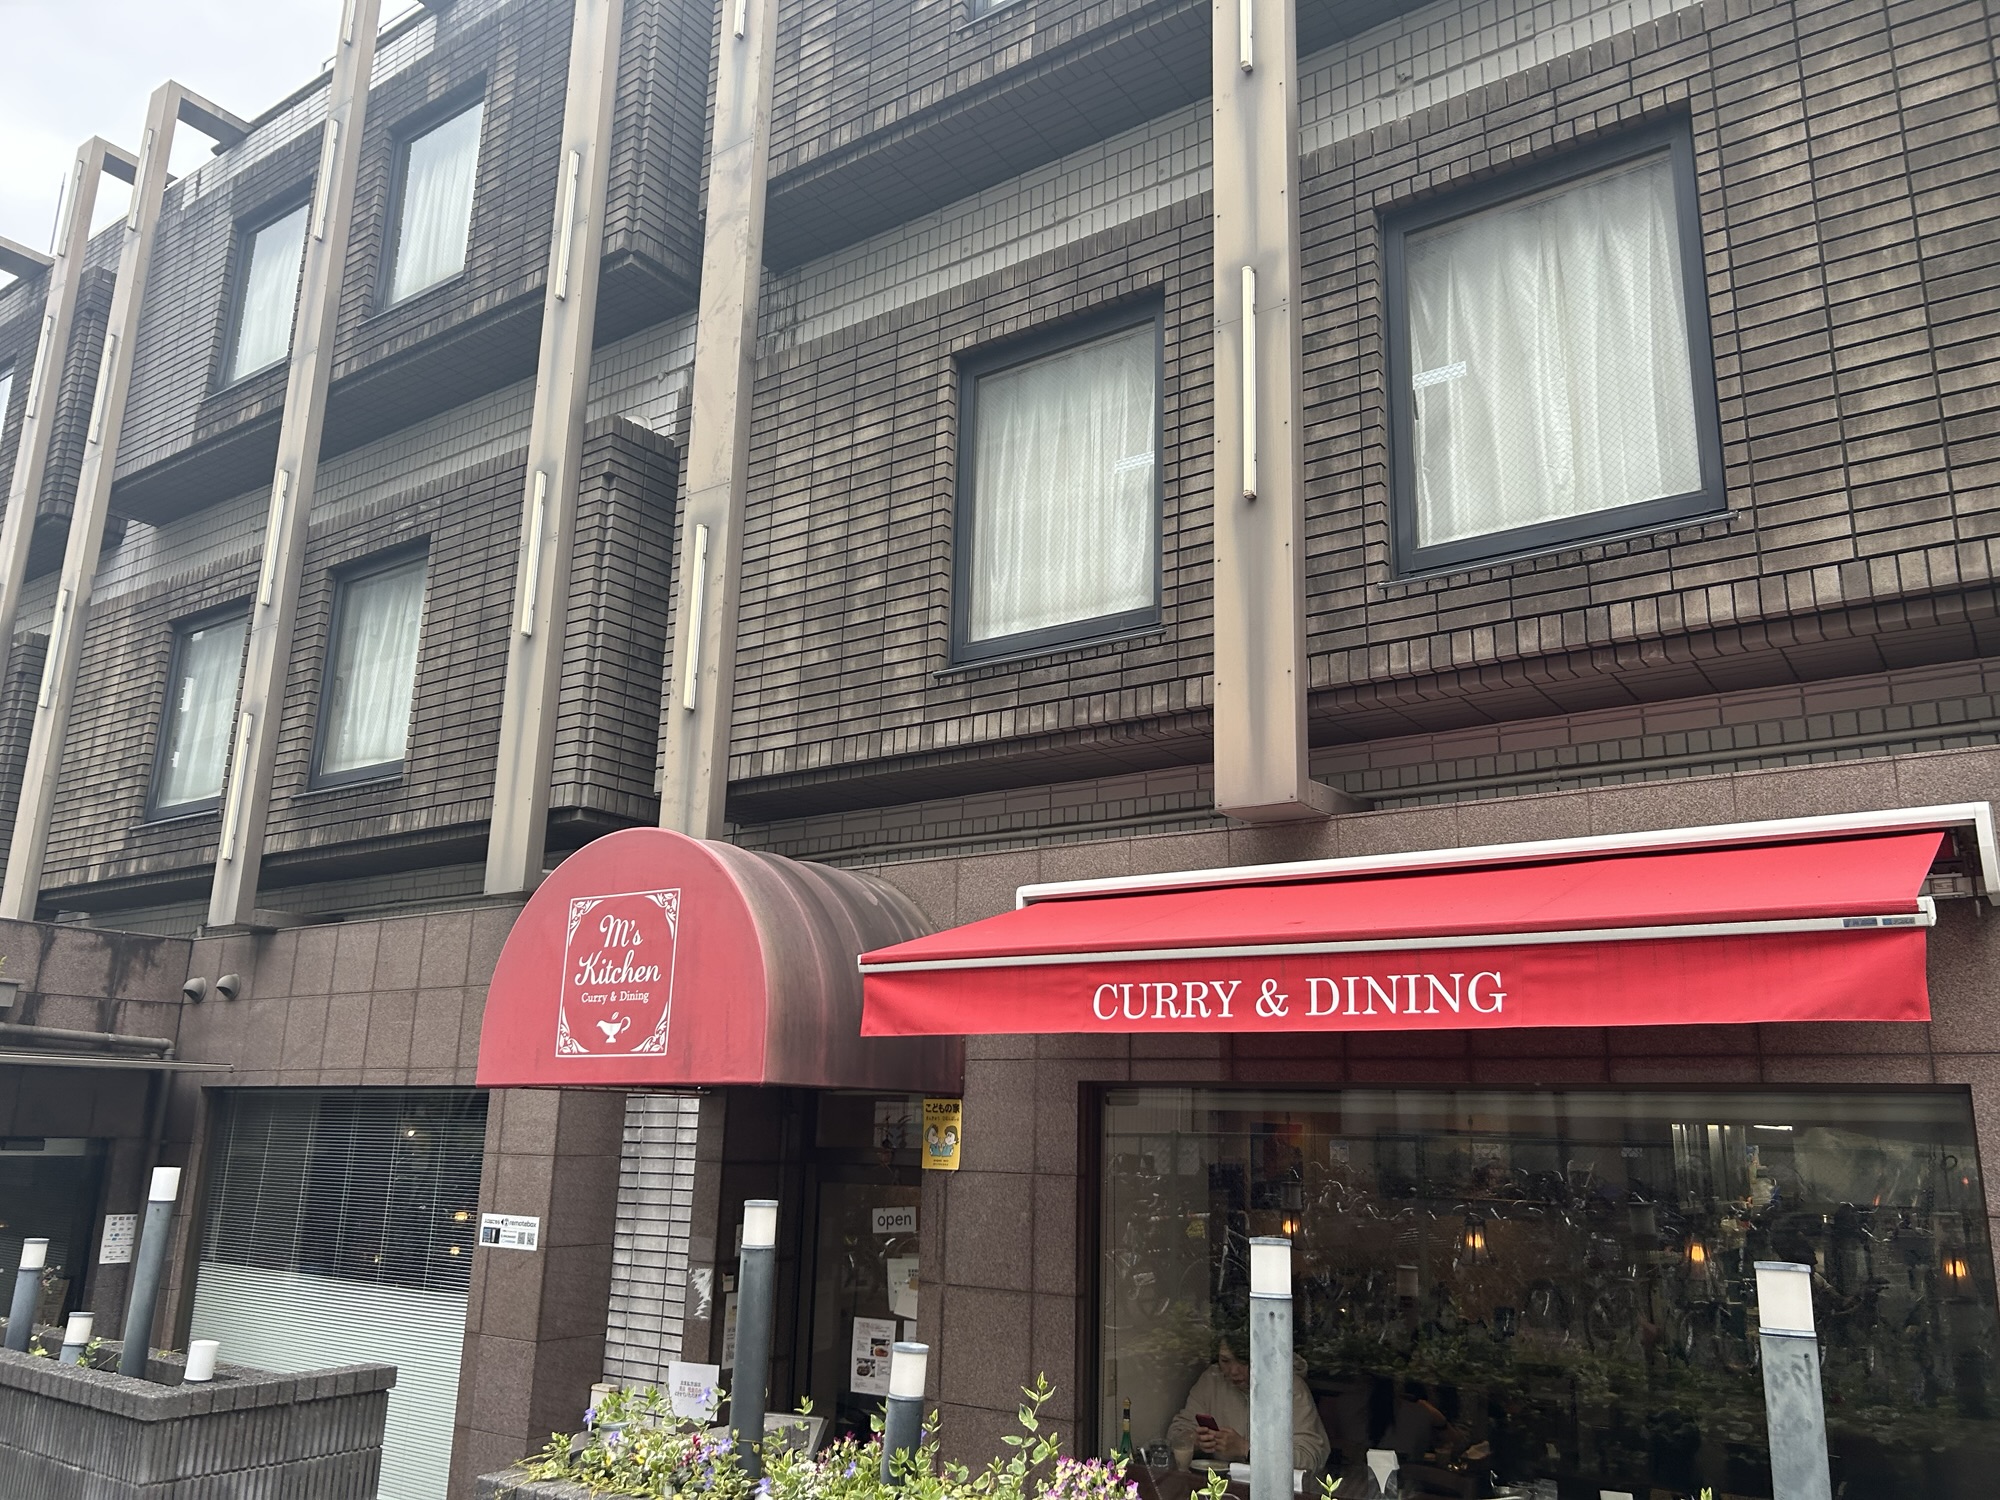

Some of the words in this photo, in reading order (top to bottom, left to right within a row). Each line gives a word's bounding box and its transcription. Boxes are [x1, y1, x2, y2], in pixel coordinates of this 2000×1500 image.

[599, 914, 644, 948] M's
[574, 949, 662, 986] Kitchen
[581, 992, 608, 1005] Curry
[610, 990, 617, 1002] &
[618, 989, 649, 1004] Dining
[1092, 980, 1242, 1020] CURRY
[1255, 978, 1289, 1018] &
[1304, 971, 1507, 1017] DINING
[925, 1103, 960, 1114] こどもの家
[877, 1214, 912, 1230] open
